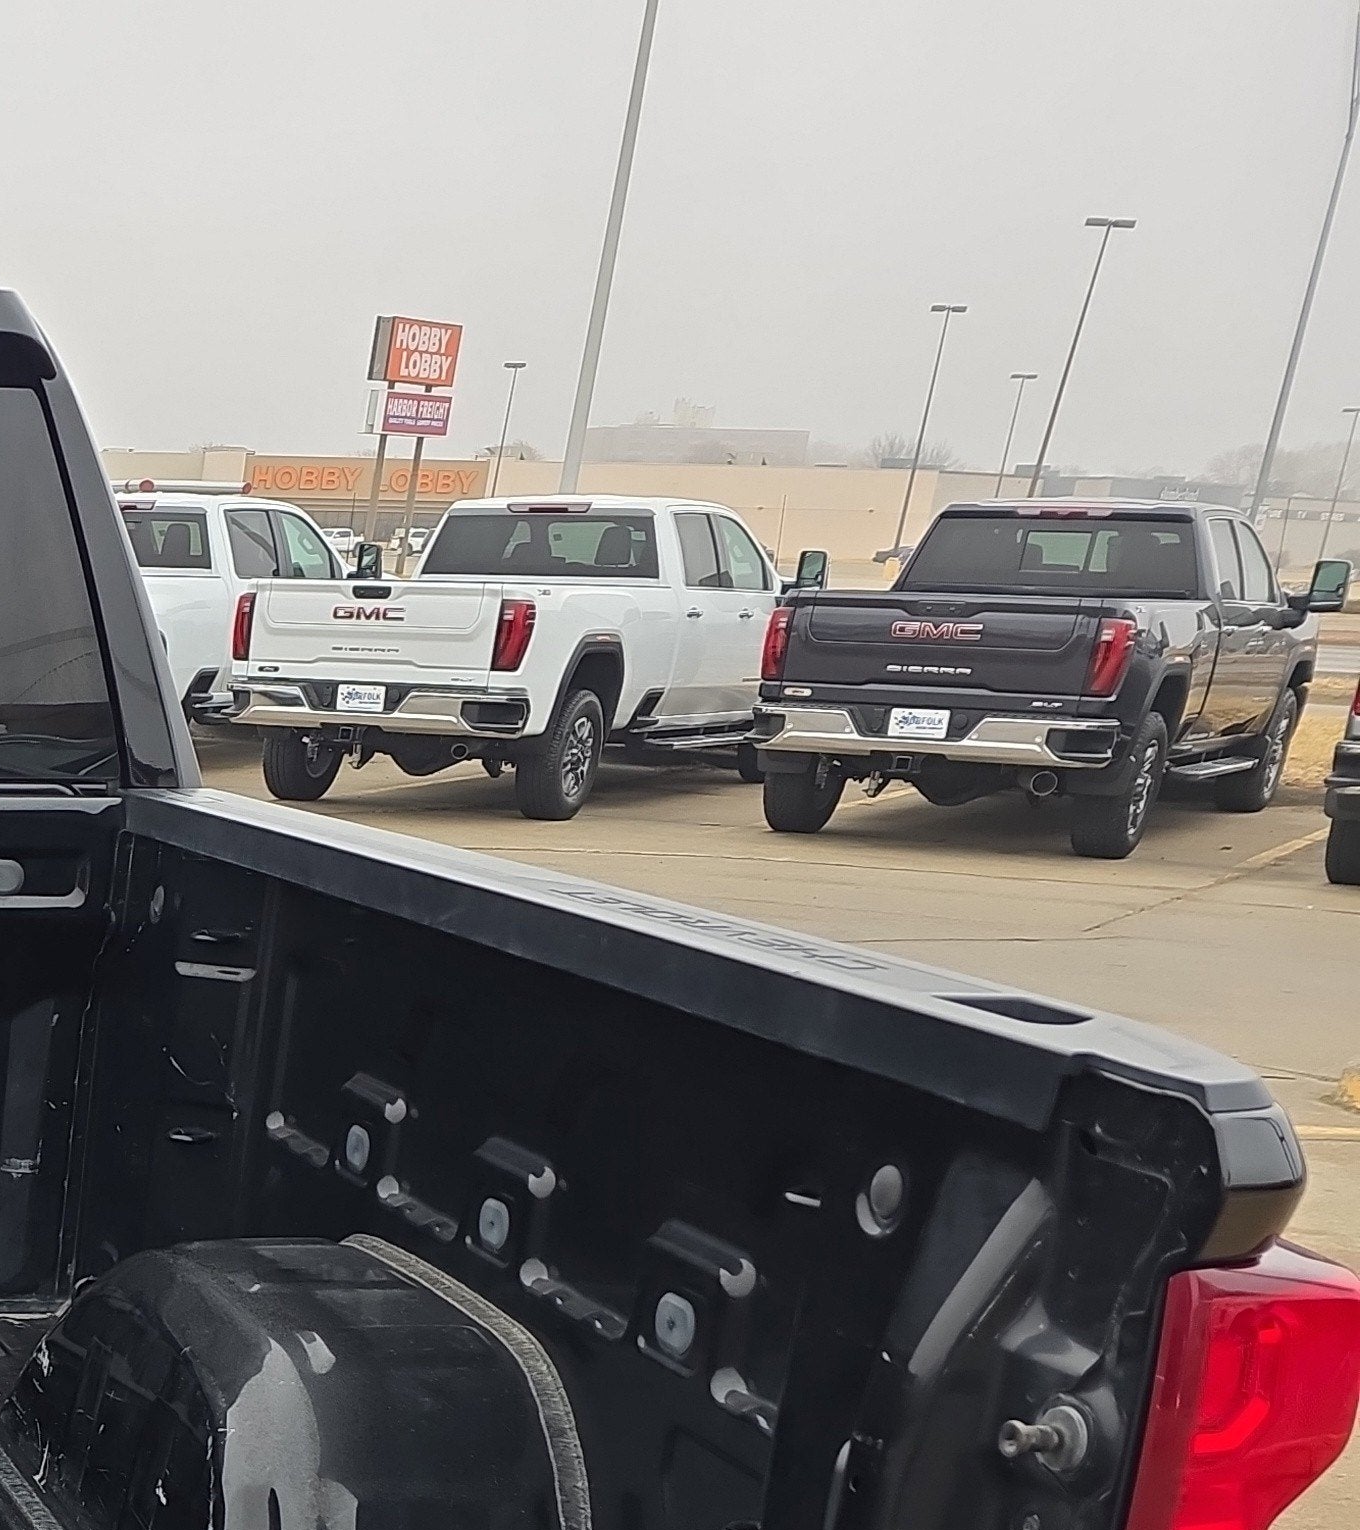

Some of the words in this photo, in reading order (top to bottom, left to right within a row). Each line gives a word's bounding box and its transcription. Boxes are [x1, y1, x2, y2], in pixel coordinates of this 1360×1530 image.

[395, 323, 453, 354] HOBBY
[399, 351, 453, 381] LOBBY
[386, 398, 418, 416] HARBOR
[417, 401, 450, 419] FREIGHT
[251, 465, 364, 491] HOBBY
[332, 606, 406, 622] GMC
[891, 620, 984, 641] GMC
[885, 664, 973, 675] SIERRA
[548, 888, 890, 971] CHEVROLET
